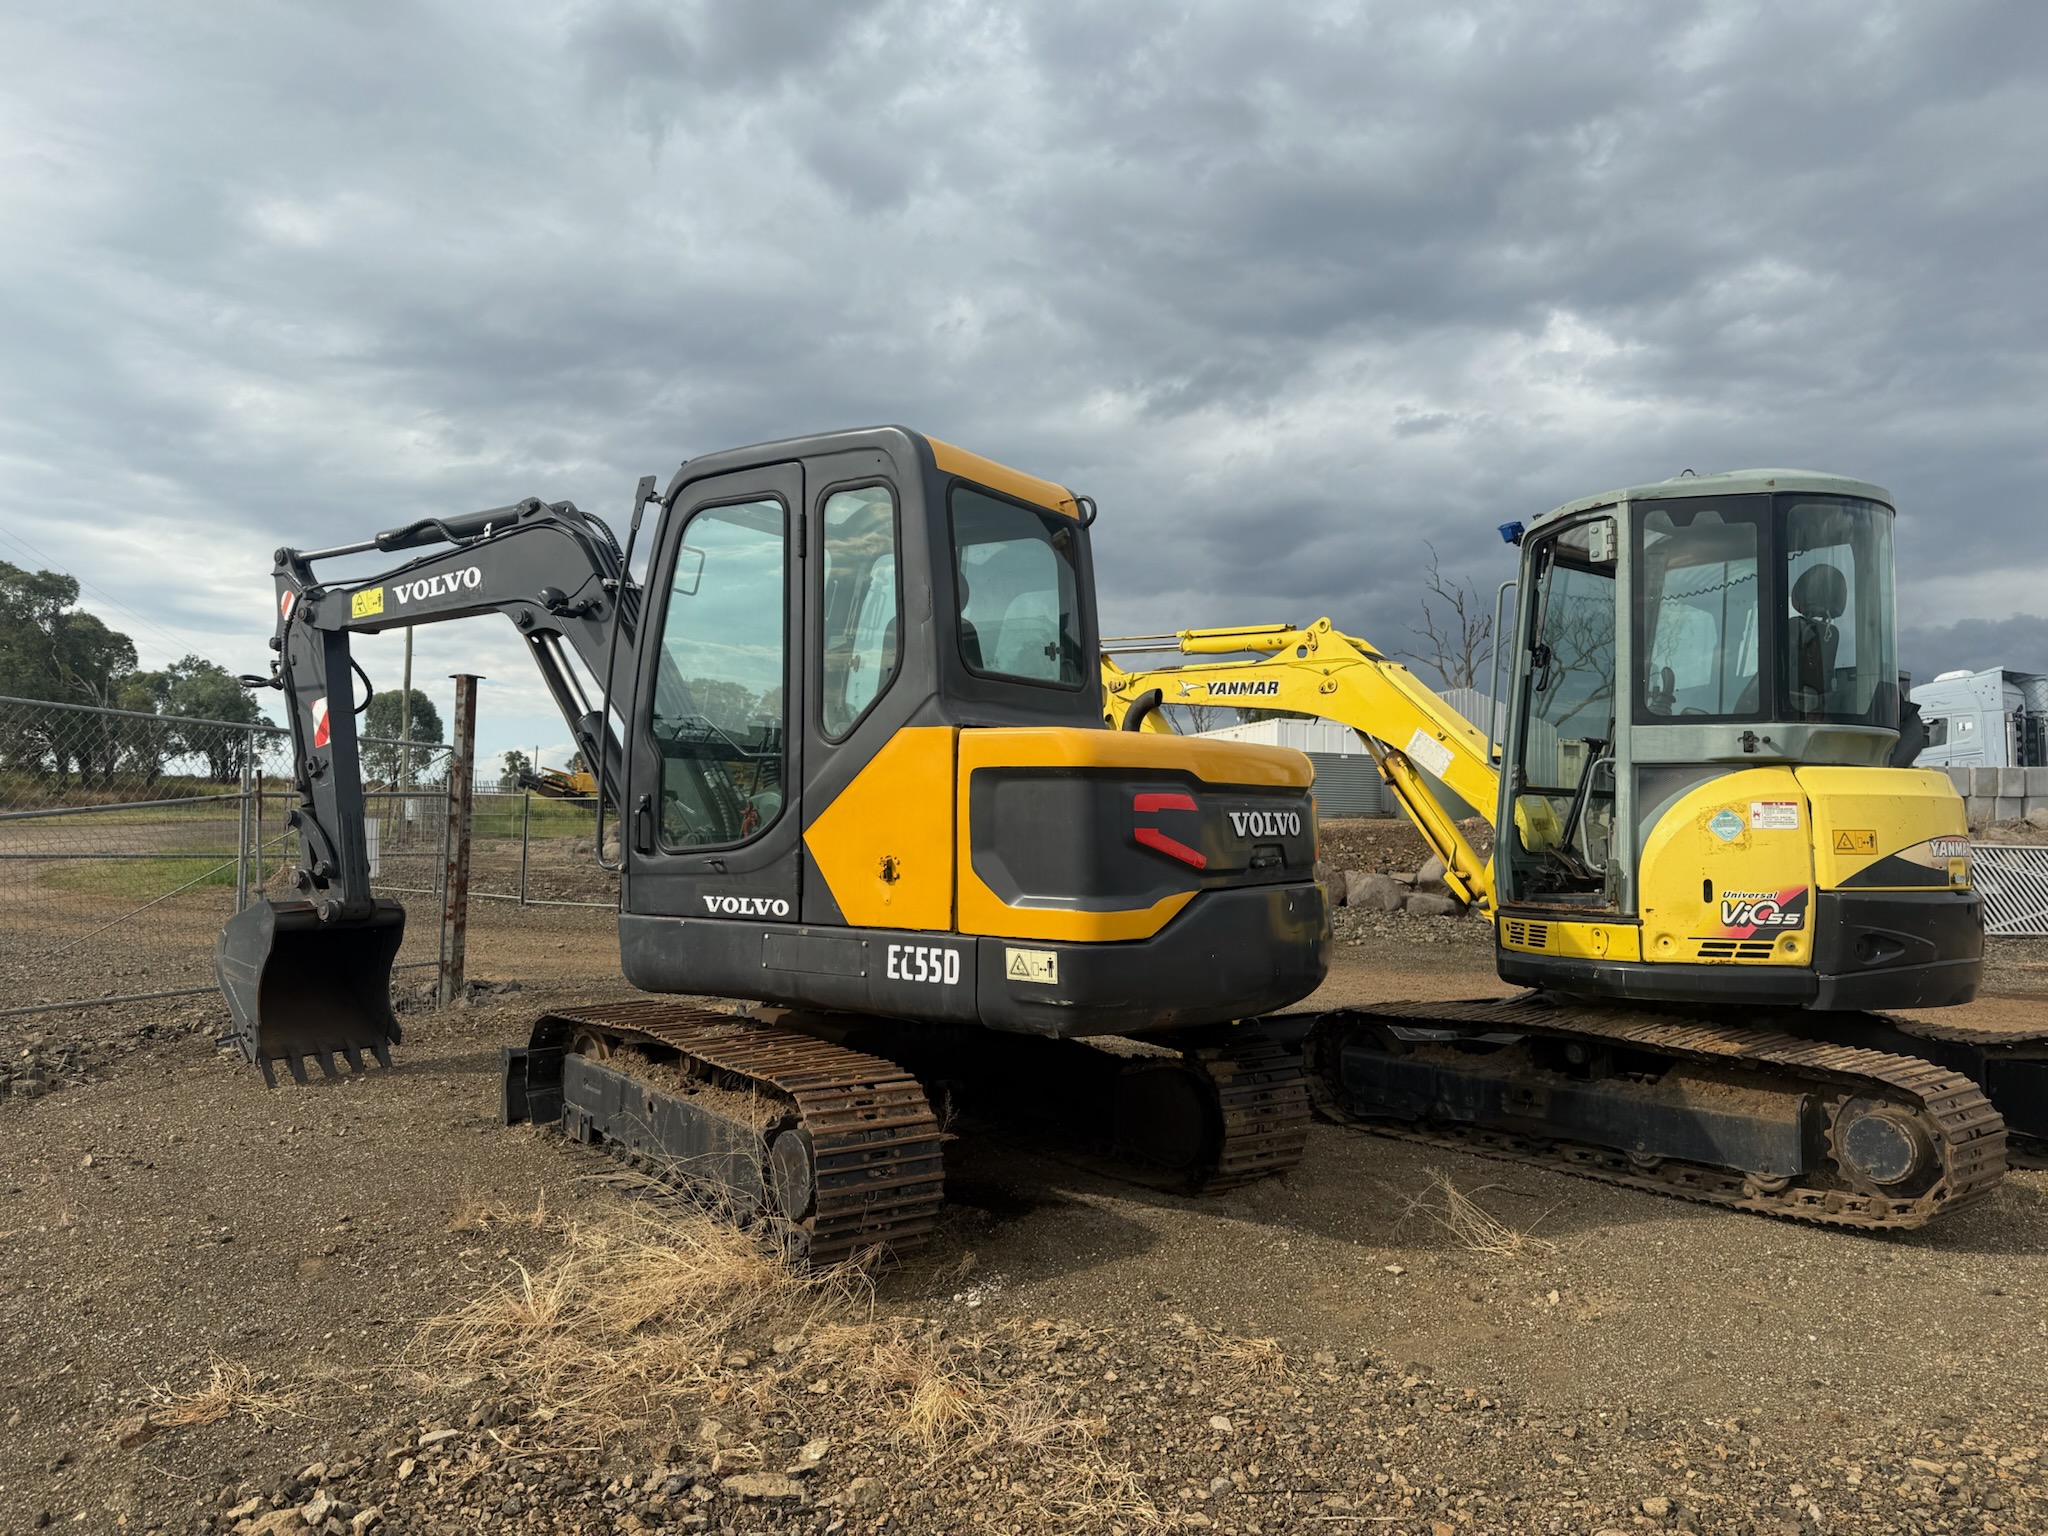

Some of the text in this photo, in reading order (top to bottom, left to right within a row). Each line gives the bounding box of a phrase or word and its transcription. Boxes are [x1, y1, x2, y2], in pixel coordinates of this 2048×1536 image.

[392, 566, 482, 605] VOLVO
[1206, 681, 1279, 695] YANMAR
[1229, 811, 1301, 837] VOLVO
[1929, 840, 1970, 857] YANMA
[702, 895, 790, 917] VOLVO
[1722, 891, 1778, 899] Universal
[887, 944, 960, 985] EC55D
